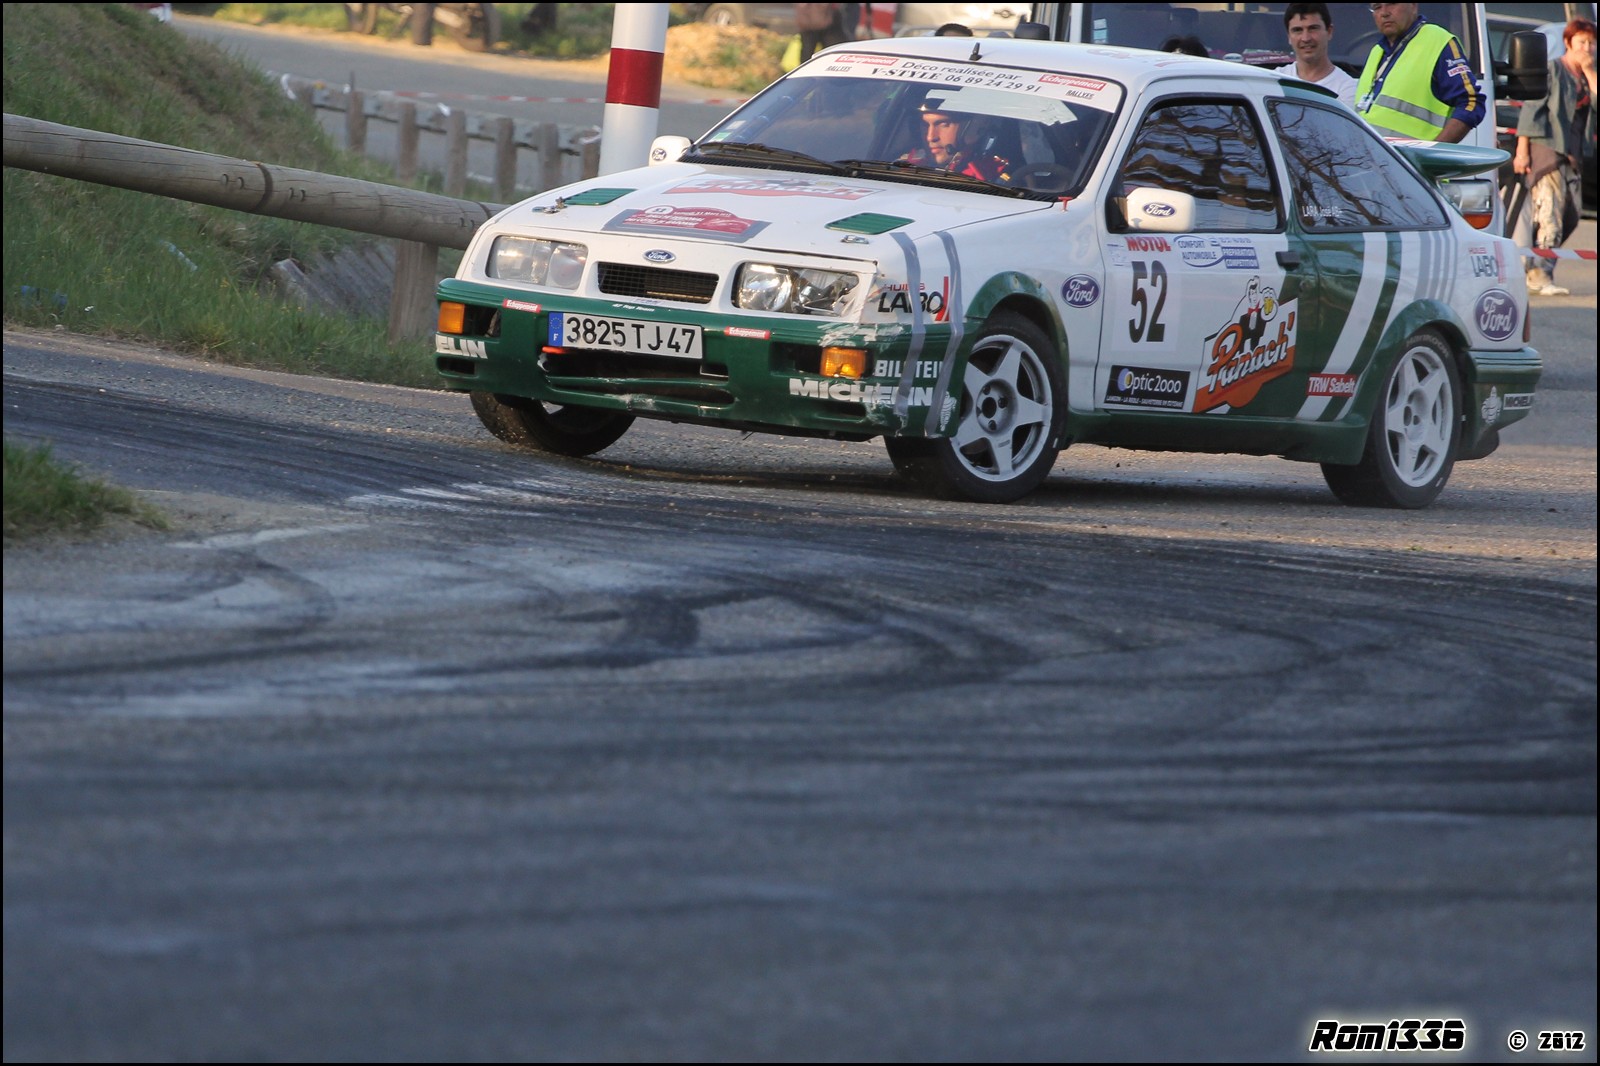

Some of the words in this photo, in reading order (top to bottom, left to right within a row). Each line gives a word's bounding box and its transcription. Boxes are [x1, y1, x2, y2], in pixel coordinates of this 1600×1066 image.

[902, 61, 938, 71] Déco
[995, 73, 1022, 81] par
[871, 67, 942, 80] V-STYLE
[945, 74, 961, 83] 06
[965, 76, 983, 85] 89
[985, 78, 1001, 88] 24
[1004, 81, 1023, 90] 29
[1025, 83, 1042, 93] 91
[1065, 89, 1094, 100] RALLYES
[1145, 203, 1171, 216] Ford
[1125, 236, 1172, 253] MOTUL
[1178, 240, 1205, 249] CONFORT
[647, 251, 668, 261] Ford
[1182, 251, 1217, 260] AUTOMOBILE
[1066, 279, 1095, 302] Ford
[1129, 260, 1168, 343] 52
[1480, 296, 1512, 332] Ford
[553, 333, 559, 342] F
[1308, 376, 1330, 393] TRW
[1330, 377, 1355, 394] Sabelt
